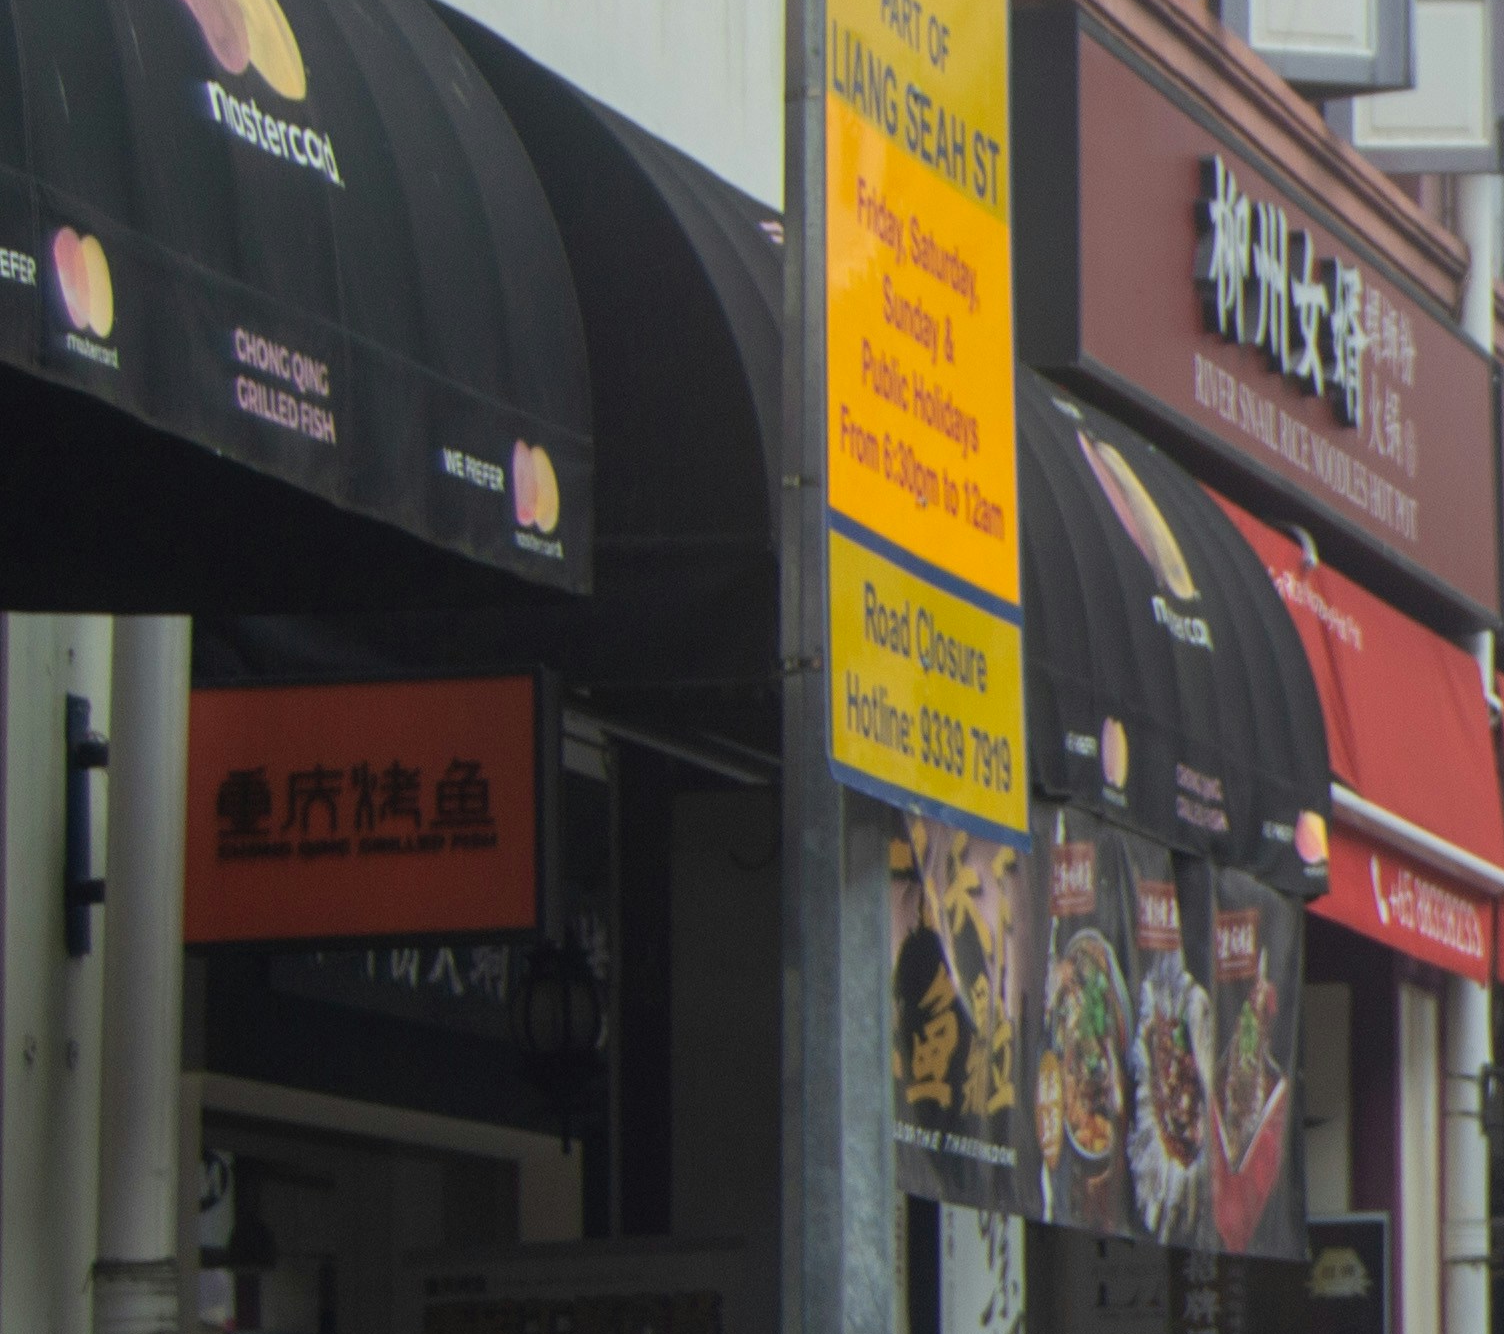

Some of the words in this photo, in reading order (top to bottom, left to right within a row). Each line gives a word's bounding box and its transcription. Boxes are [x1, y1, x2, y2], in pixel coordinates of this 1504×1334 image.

[927, 14, 951, 72] OF
[830, 19, 898, 138] LIANG
[904, 79, 968, 189] SEAH
[972, 130, 1001, 206] ST
[856, 177, 908, 261] Friday,
[908, 214, 980, 314] Saturday,
[882, 273, 939, 365] Sunday
[943, 315, 956, 364] &
[861, 336, 911, 415] Public
[912, 373, 981, 459] Holidays
[839, 403, 880, 467] From
[942, 468, 961, 519] to
[963, 476, 1006, 543] 12am
[863, 580, 912, 654] Road
[914, 606, 988, 694] Closure
[845, 669, 916, 758] Hotline:
[919, 703, 966, 779] 9339
[969, 727, 1013, 793] 7919
